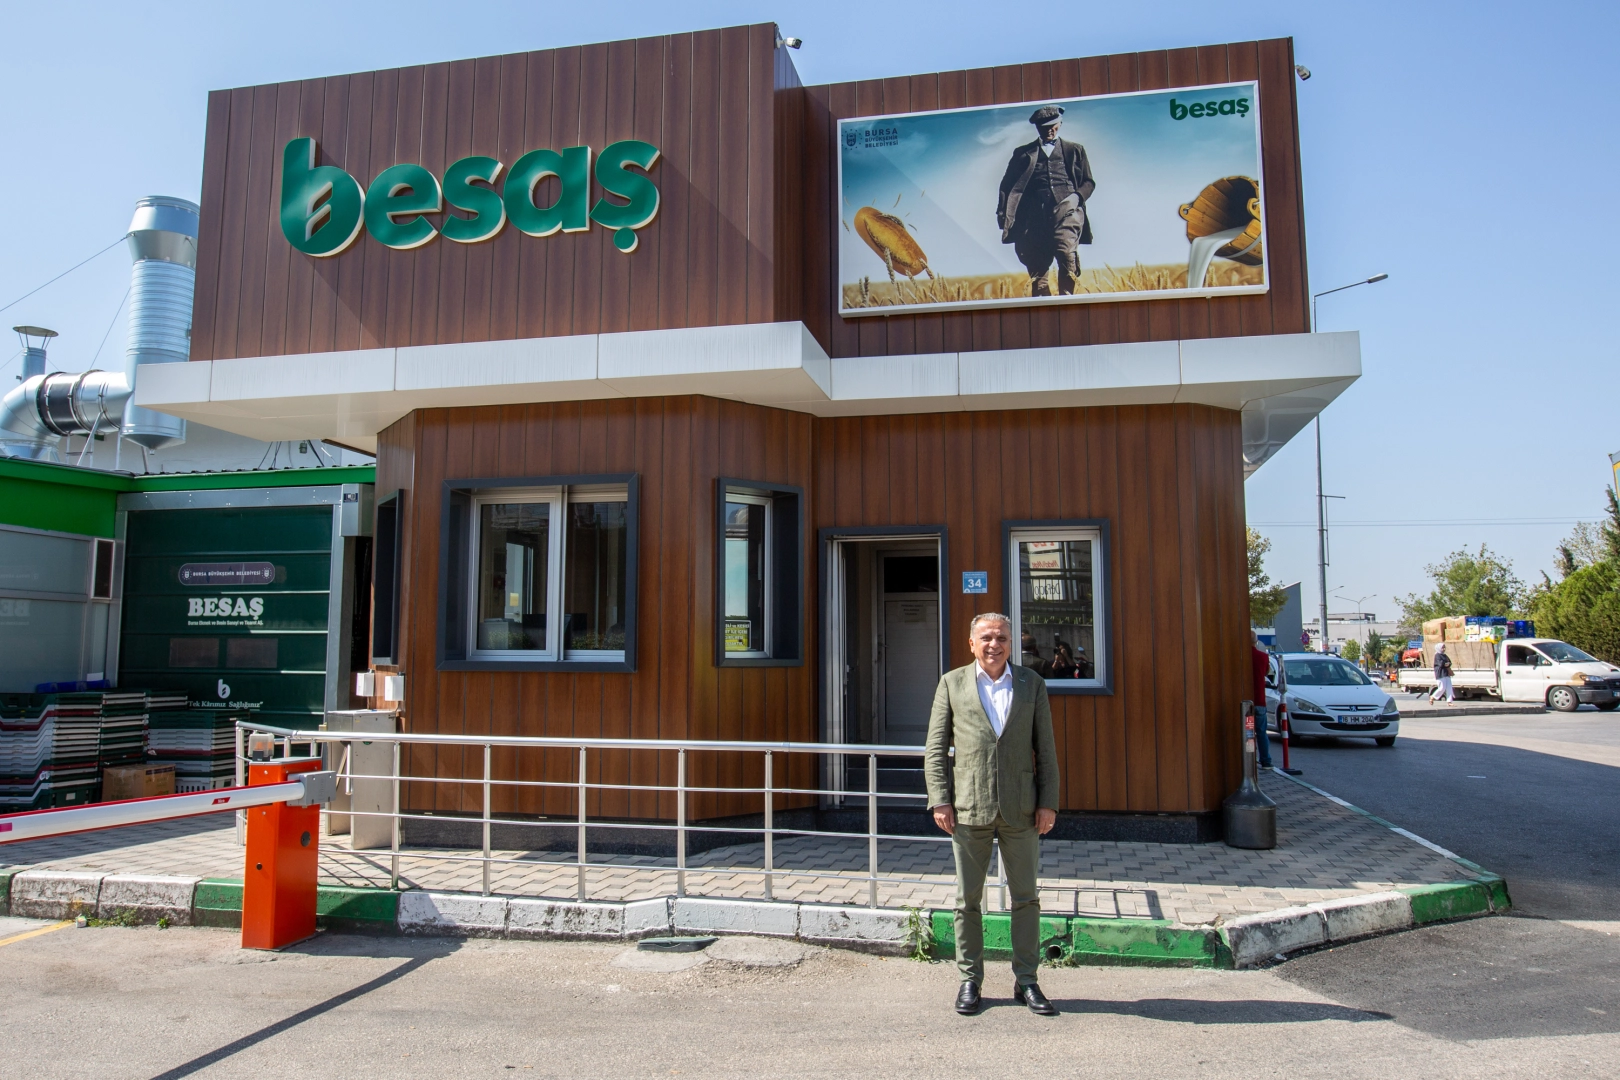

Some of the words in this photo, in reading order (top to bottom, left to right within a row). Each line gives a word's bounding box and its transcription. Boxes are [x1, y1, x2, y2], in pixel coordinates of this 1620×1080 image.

[1169, 98, 1250, 120] besaş
[864, 127, 898, 137] BURSA
[864, 140, 899, 148] BELEDİYESİ
[280, 136, 661, 258] besaş
[967, 578, 982, 588] 34
[187, 597, 264, 620] BESAŞ
